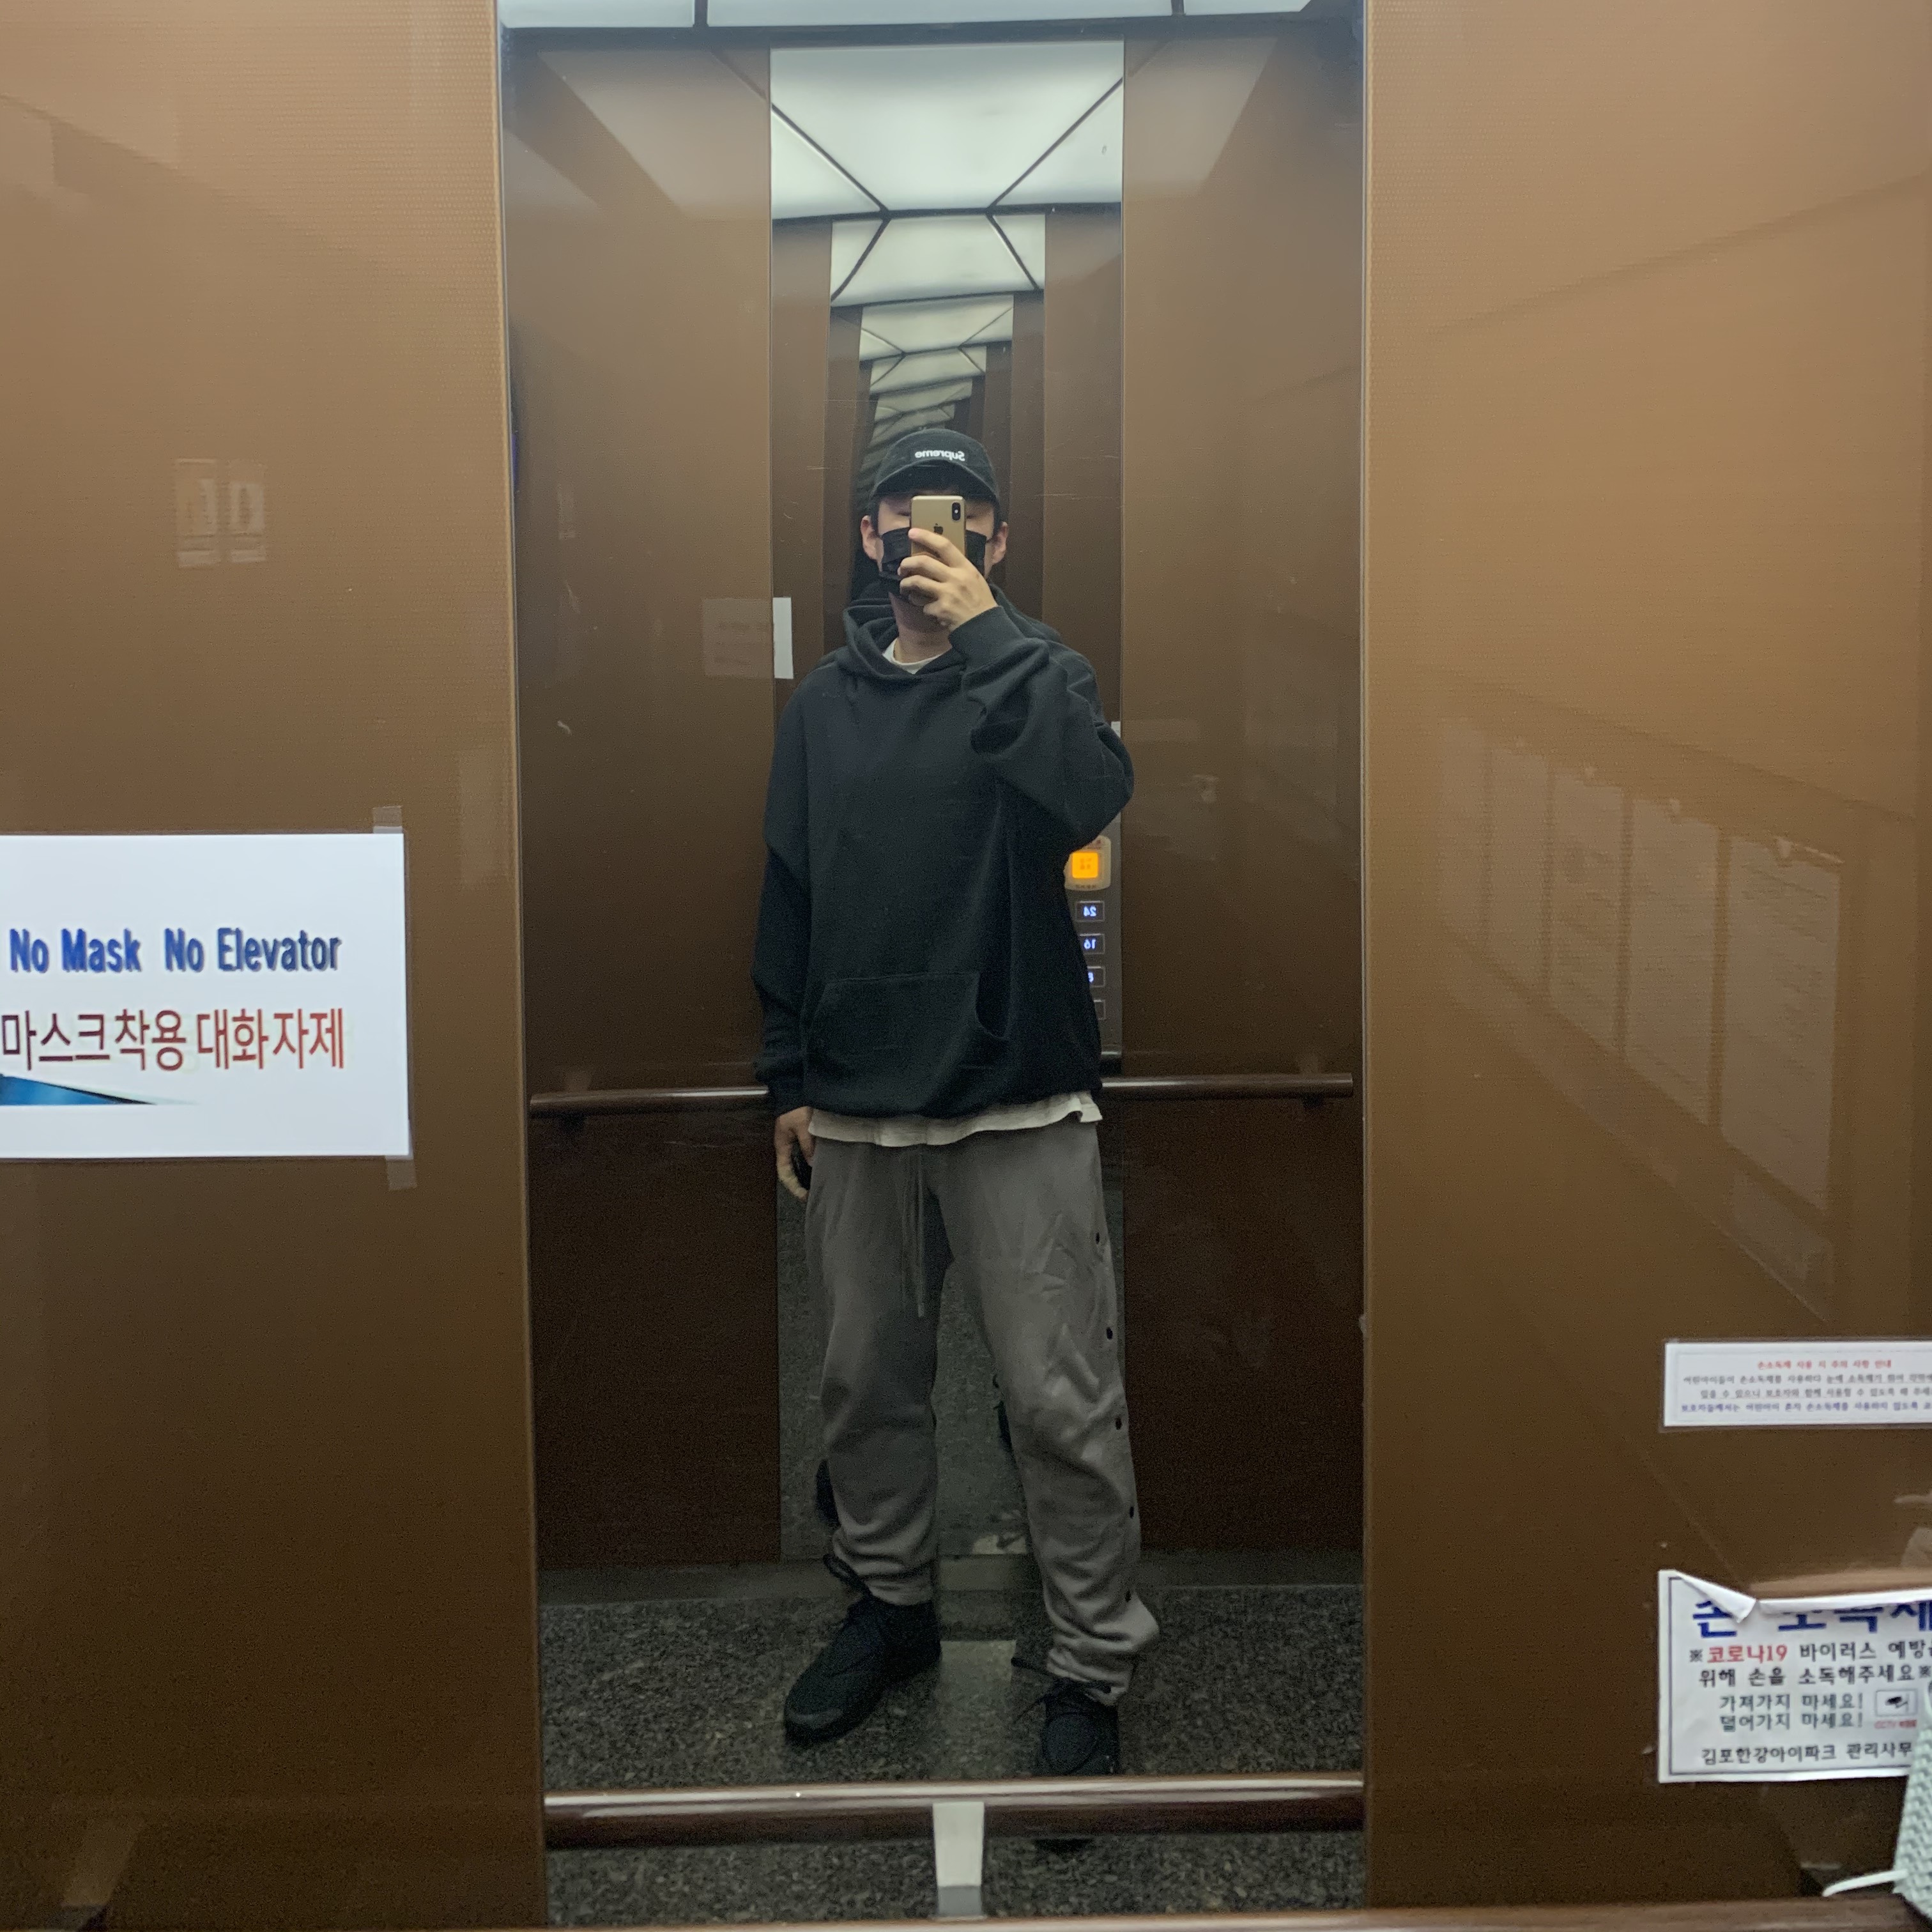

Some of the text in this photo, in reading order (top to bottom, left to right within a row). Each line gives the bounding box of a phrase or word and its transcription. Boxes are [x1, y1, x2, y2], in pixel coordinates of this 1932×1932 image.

[10, 928, 342, 973] No Mask No Elevator
[1, 1008, 344, 1071] 마스크착용 대화자제
[1799, 1641, 1876, 1662] 바이러스
[1888, 1639, 1932, 1660] 예방
[1699, 1667, 1736, 1688] 위해
[1748, 1666, 1786, 1687] 손을
[1719, 1692, 1862, 1713] 가져가지 마세요!
[1719, 1712, 1862, 1732] 덜어가지 마세요!
[1701, 1744, 1837, 1766] 김포한강아이파크
